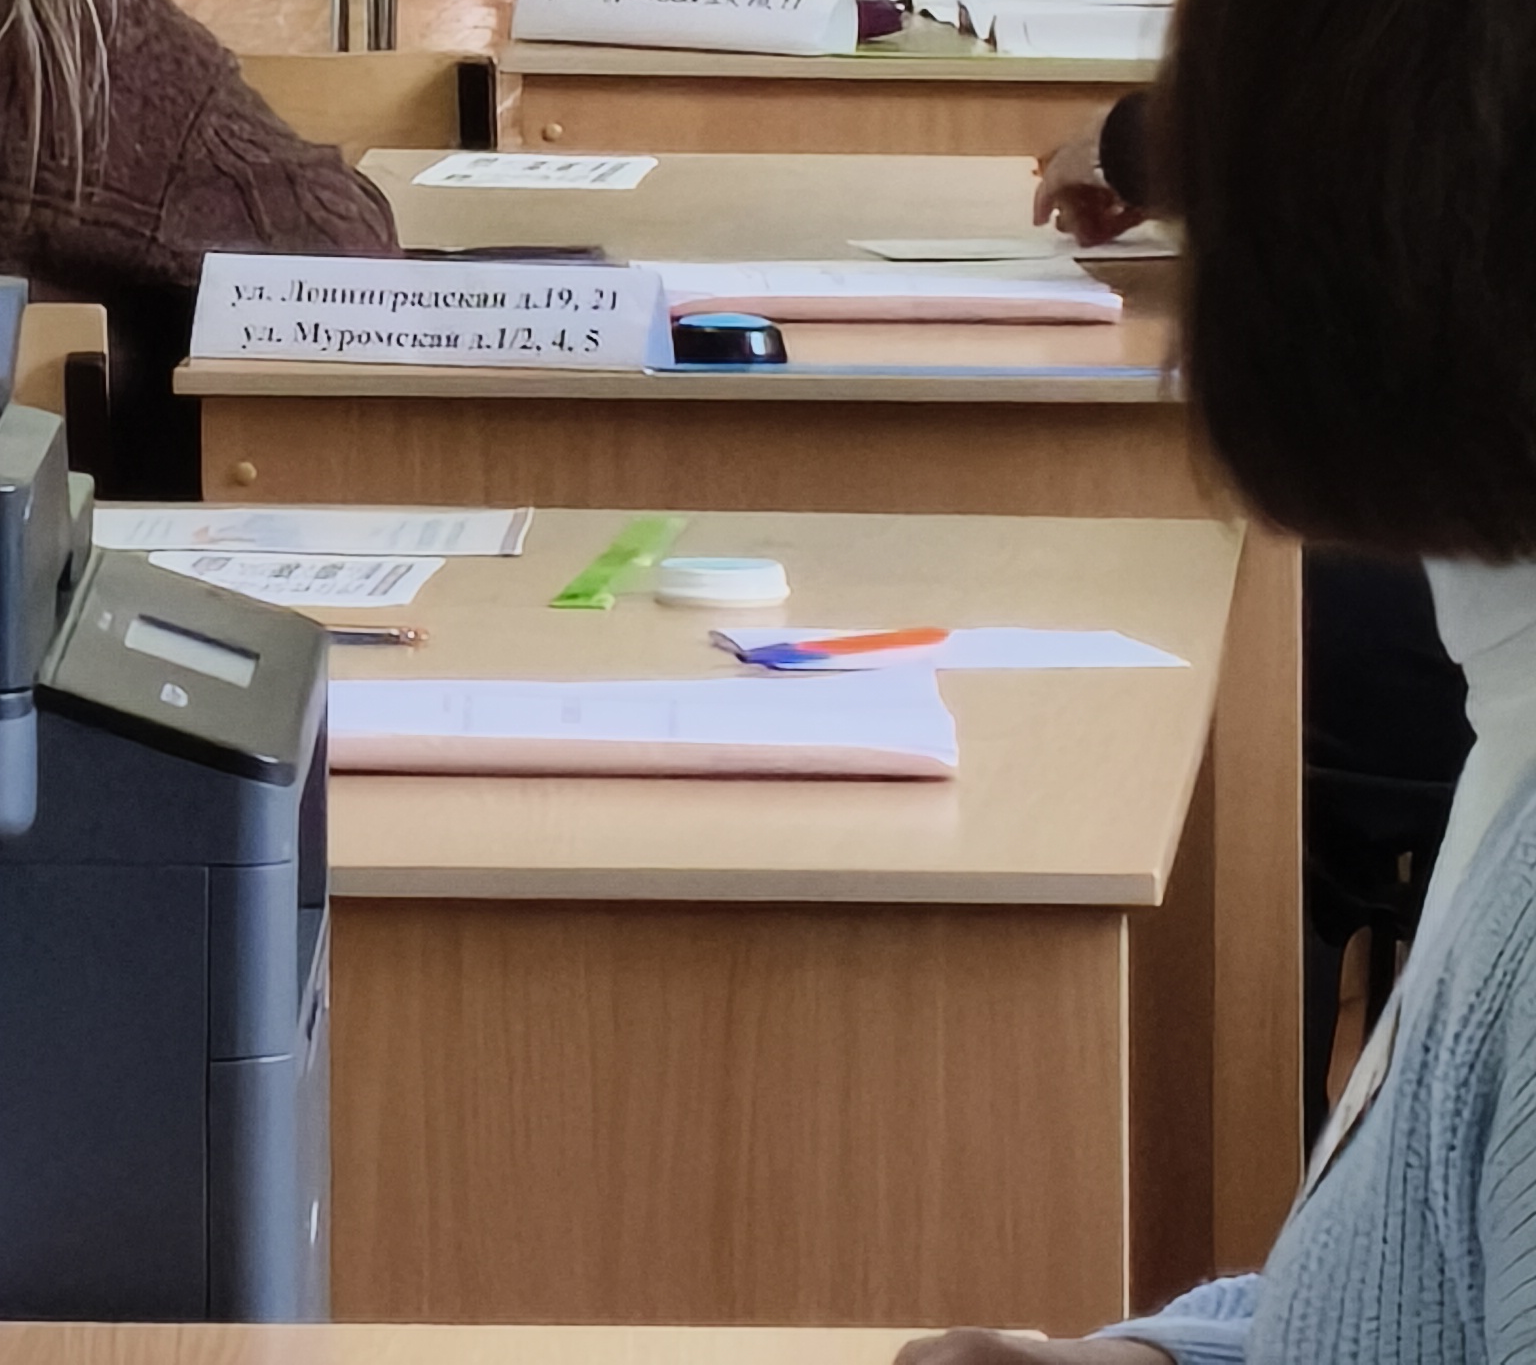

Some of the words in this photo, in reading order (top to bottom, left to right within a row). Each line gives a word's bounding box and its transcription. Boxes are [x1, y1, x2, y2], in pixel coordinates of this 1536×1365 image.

[231, 284, 272, 308] ул.
[241, 325, 283, 350] ул.
[293, 320, 460, 352] Муромская
